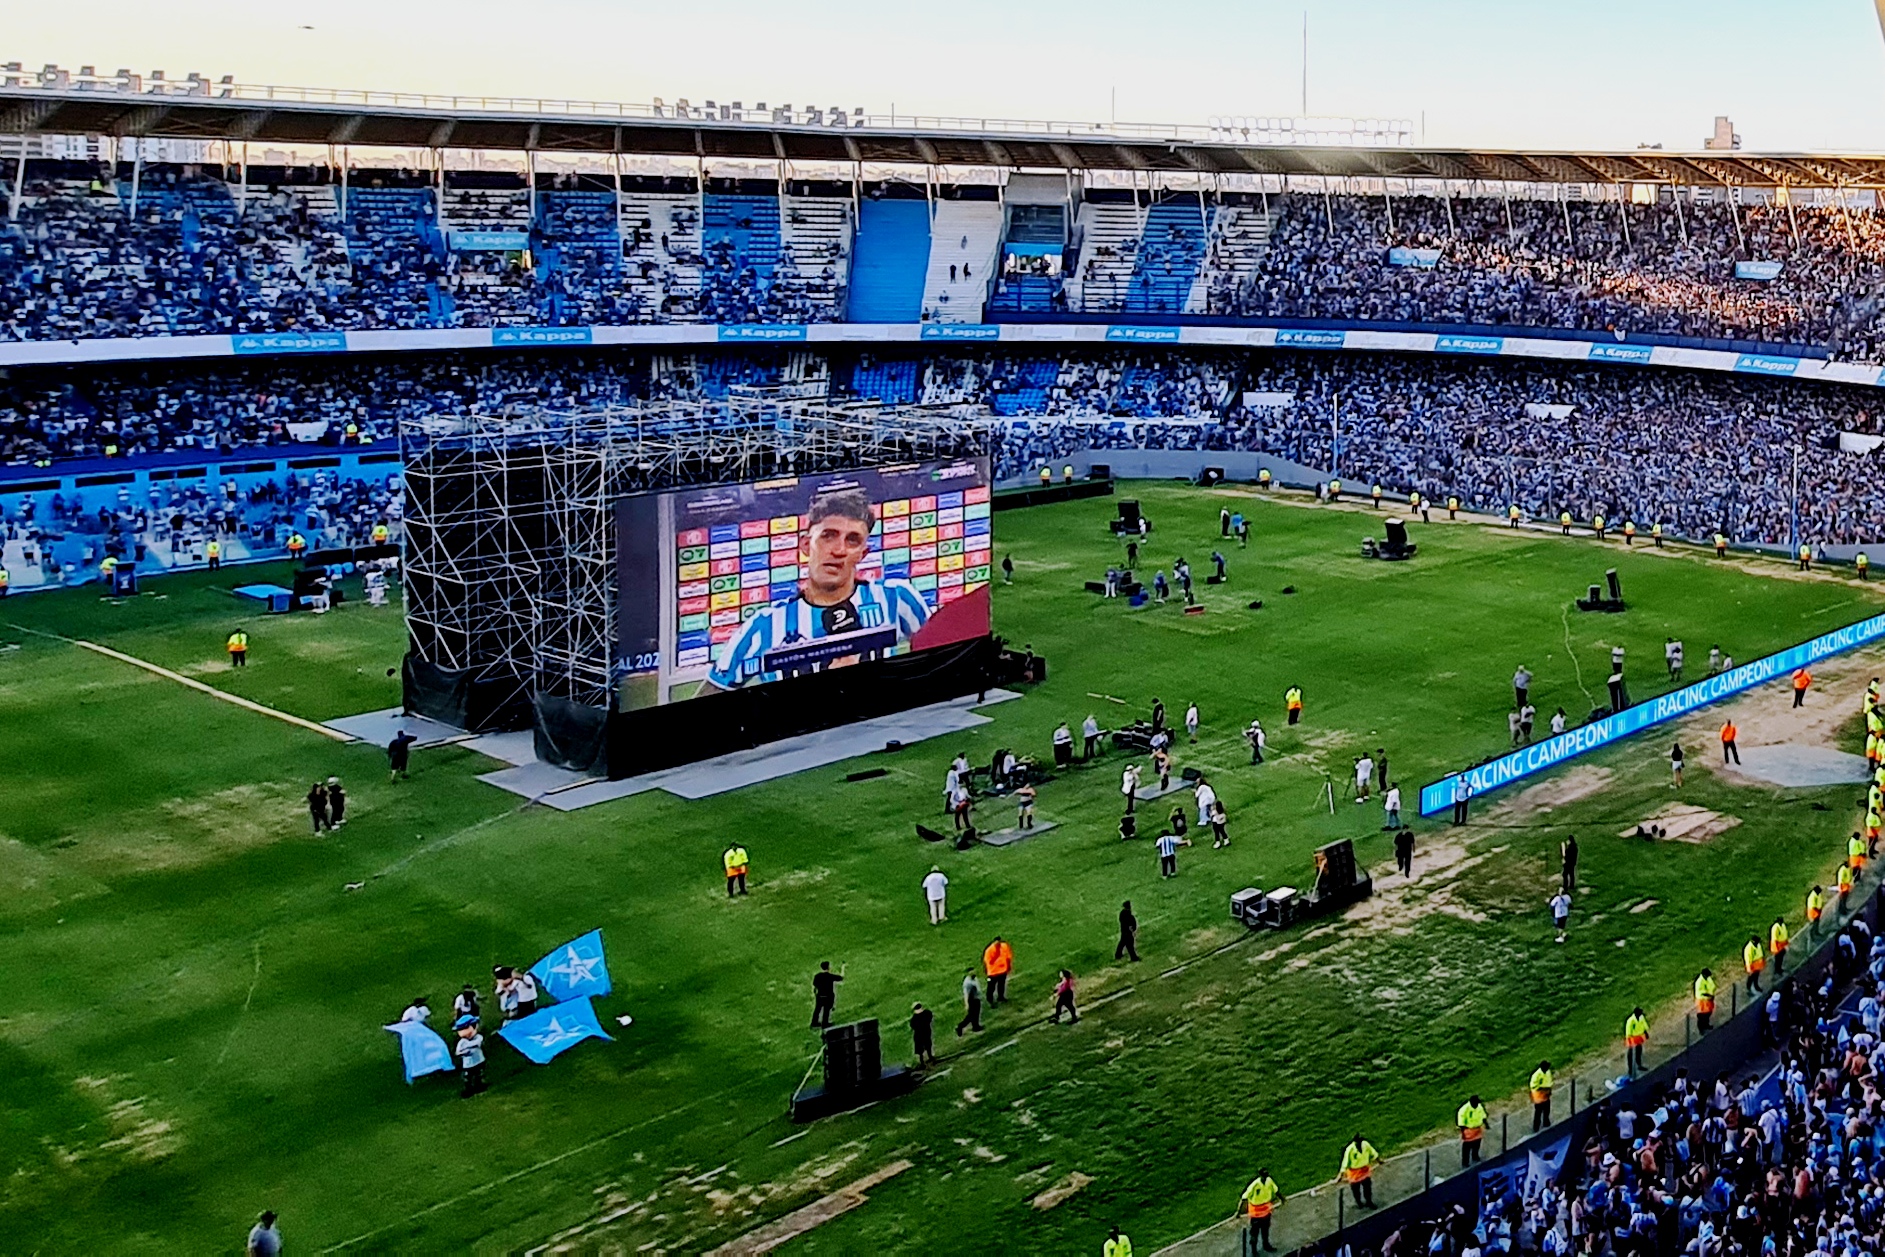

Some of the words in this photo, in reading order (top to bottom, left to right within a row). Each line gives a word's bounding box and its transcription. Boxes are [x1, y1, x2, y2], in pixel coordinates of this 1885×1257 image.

[519, 331, 586, 341] Kappa
[741, 328, 800, 338] Kappa
[943, 328, 997, 337] Kappa
[1125, 329, 1175, 339] Kappa
[1452, 339, 1498, 349] Kappa
[1752, 359, 1796, 371] Kappa
[1451, 754, 1523, 804] ¡ACING
